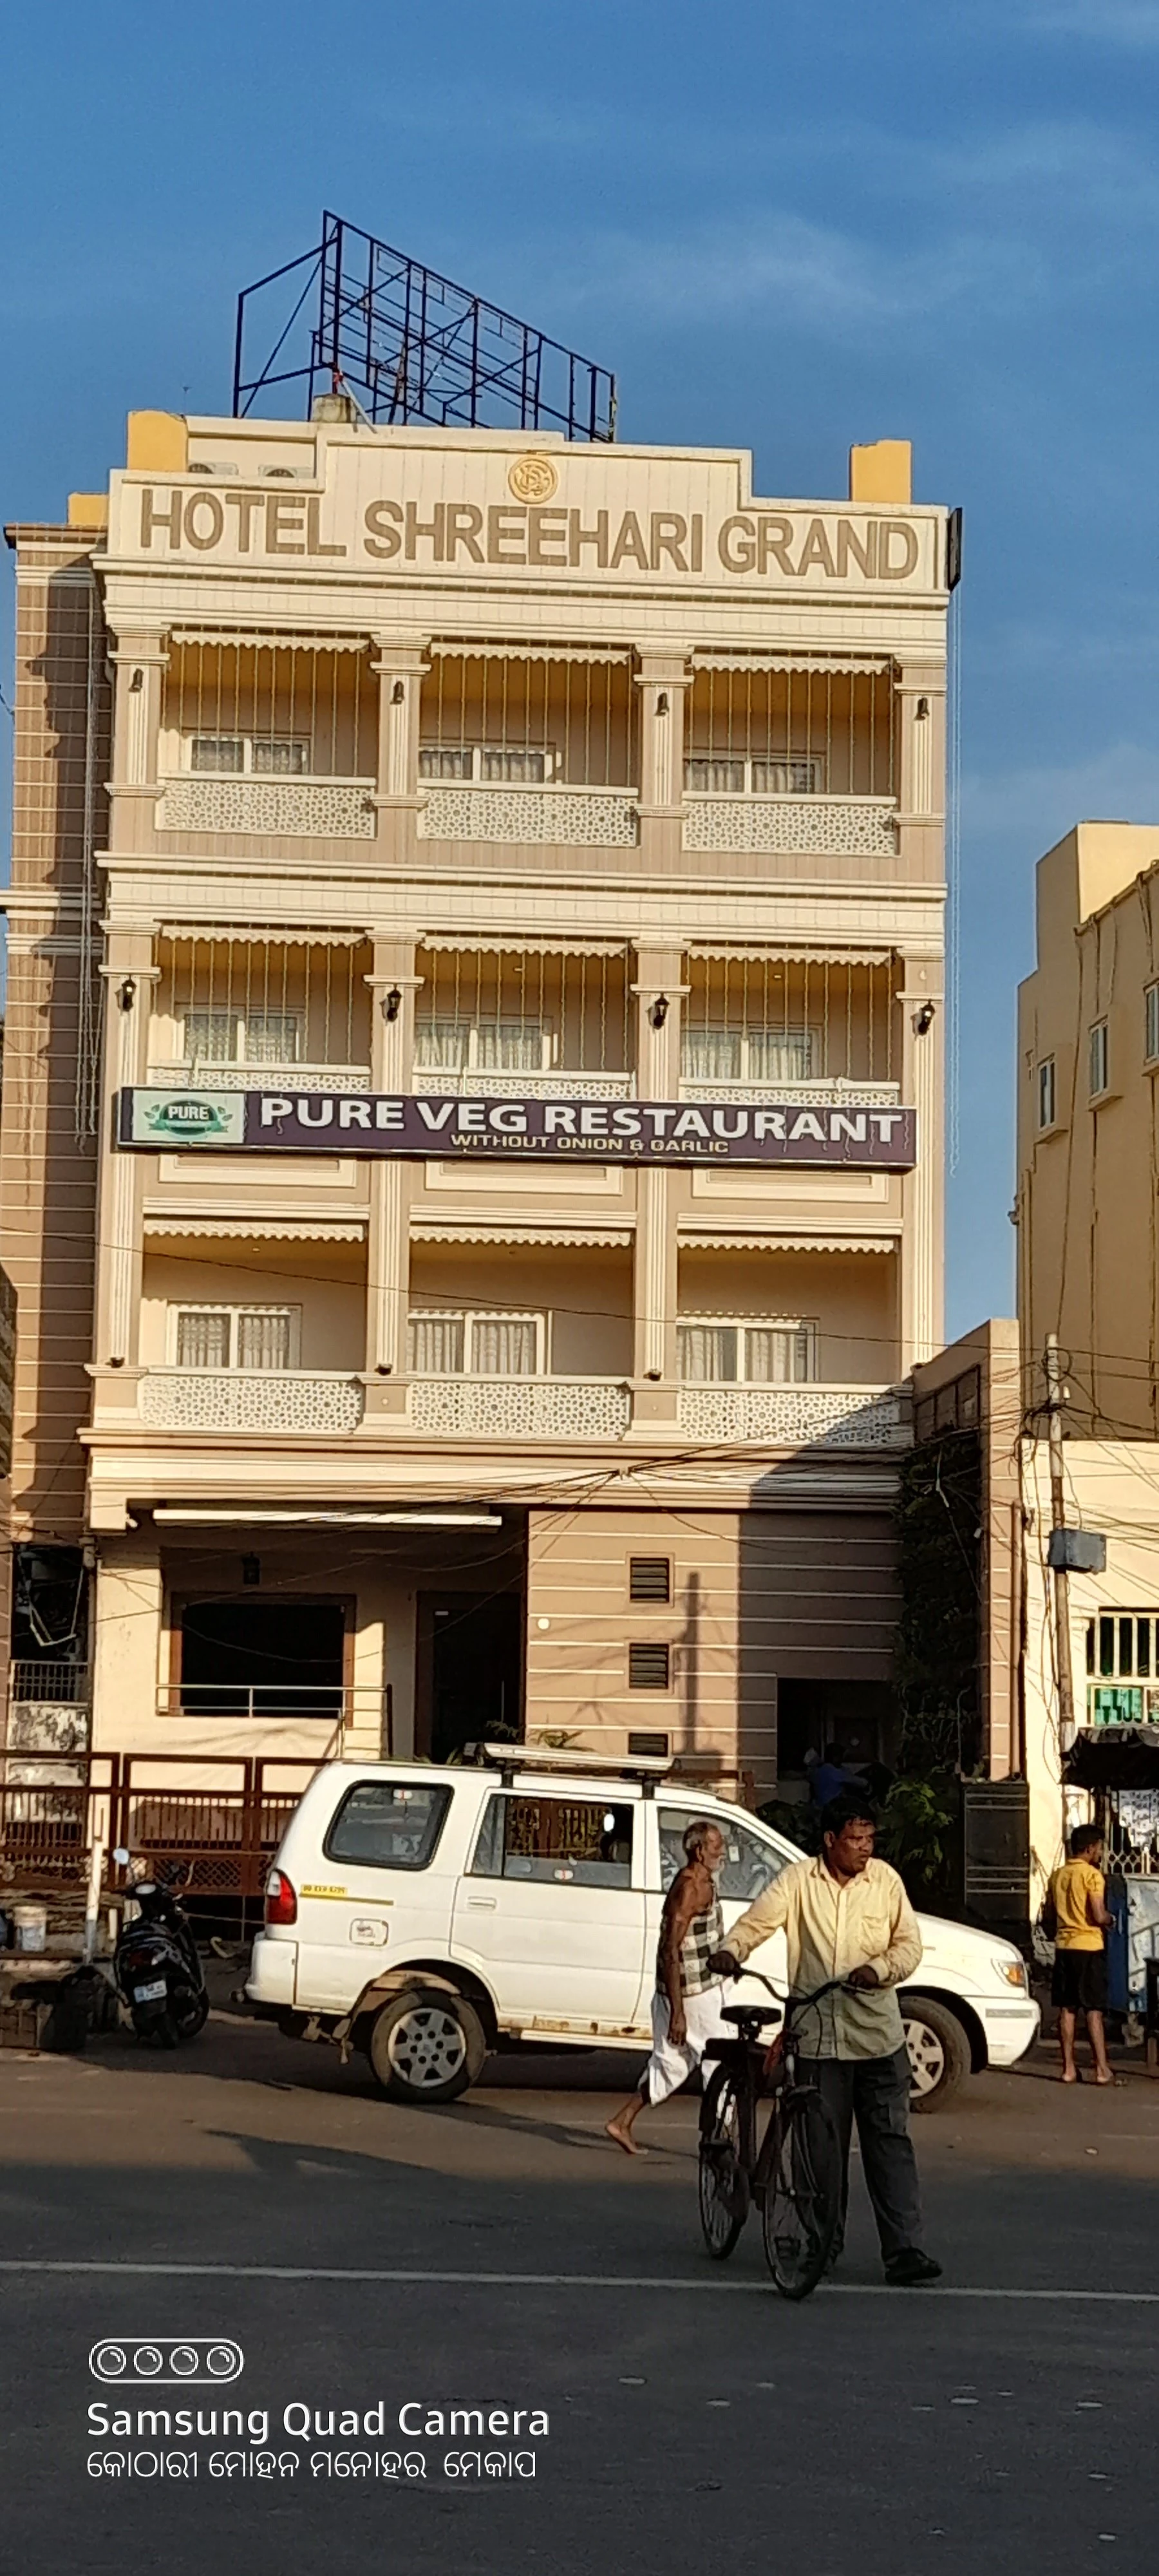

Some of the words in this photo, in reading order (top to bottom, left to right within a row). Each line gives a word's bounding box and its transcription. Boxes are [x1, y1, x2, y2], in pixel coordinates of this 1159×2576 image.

[140, 488, 347, 556] HOTEL
[363, 500, 703, 573] SHREEHARI
[717, 516, 919, 580] GRAND
[167, 1105, 209, 1121] PURE
[261, 1097, 405, 1130] PURE
[415, 1102, 527, 1132] VEG
[543, 1105, 903, 1143] RESTAURANT
[451, 1133, 550, 1148] WITHOUT
[556, 1136, 623, 1151] ONION
[629, 1139, 643, 1151] &
[650, 1139, 729, 1153] GARLIC
